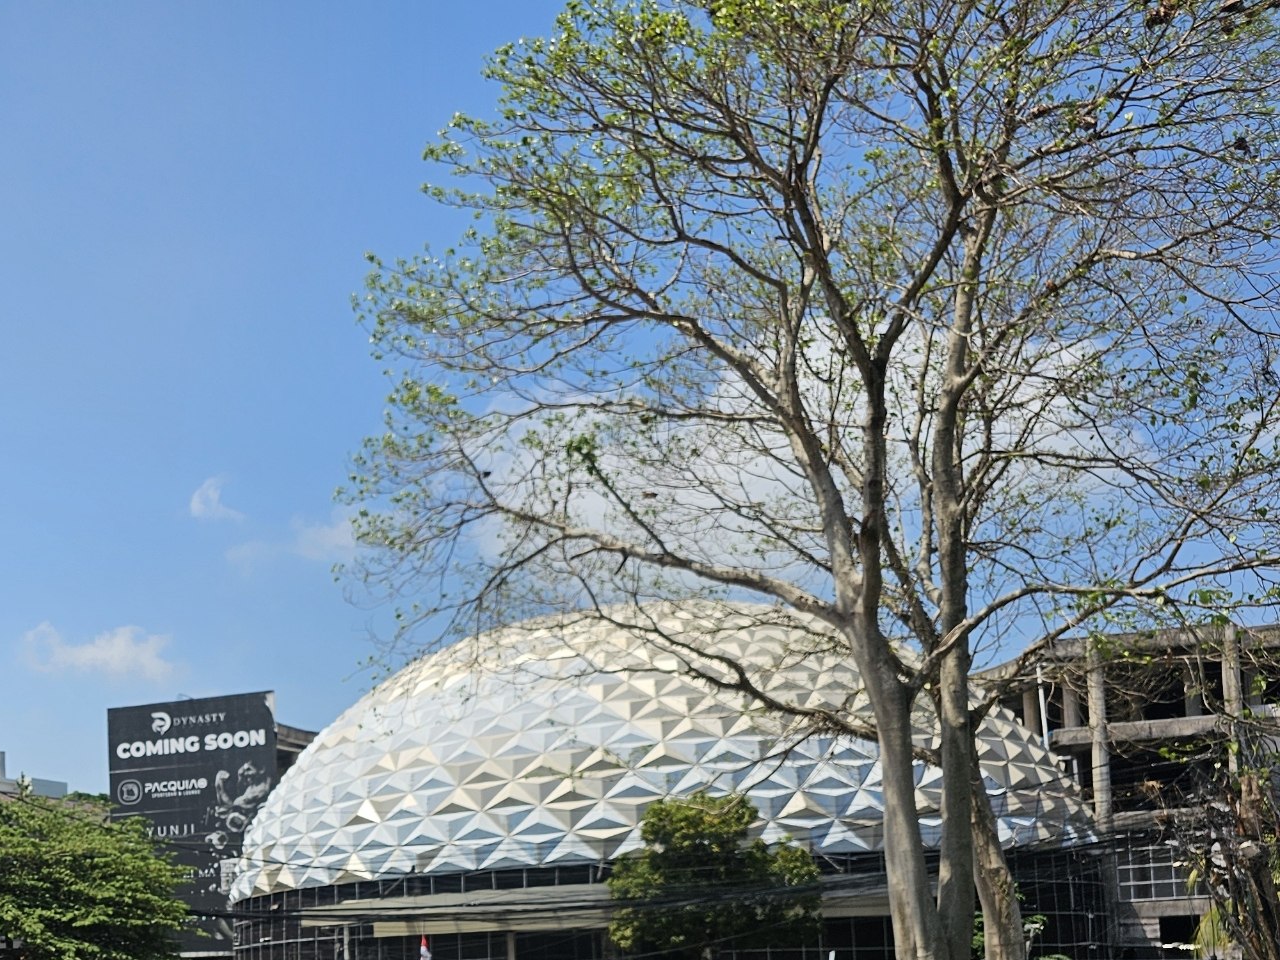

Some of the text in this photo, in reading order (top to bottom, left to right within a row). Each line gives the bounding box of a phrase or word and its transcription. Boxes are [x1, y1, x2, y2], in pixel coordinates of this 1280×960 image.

[173, 712, 227, 727] DYNASTY
[116, 729, 266, 759] COMING SOON
[144, 777, 208, 793] PACQUIAO
[146, 823, 195, 838] YUNJI
